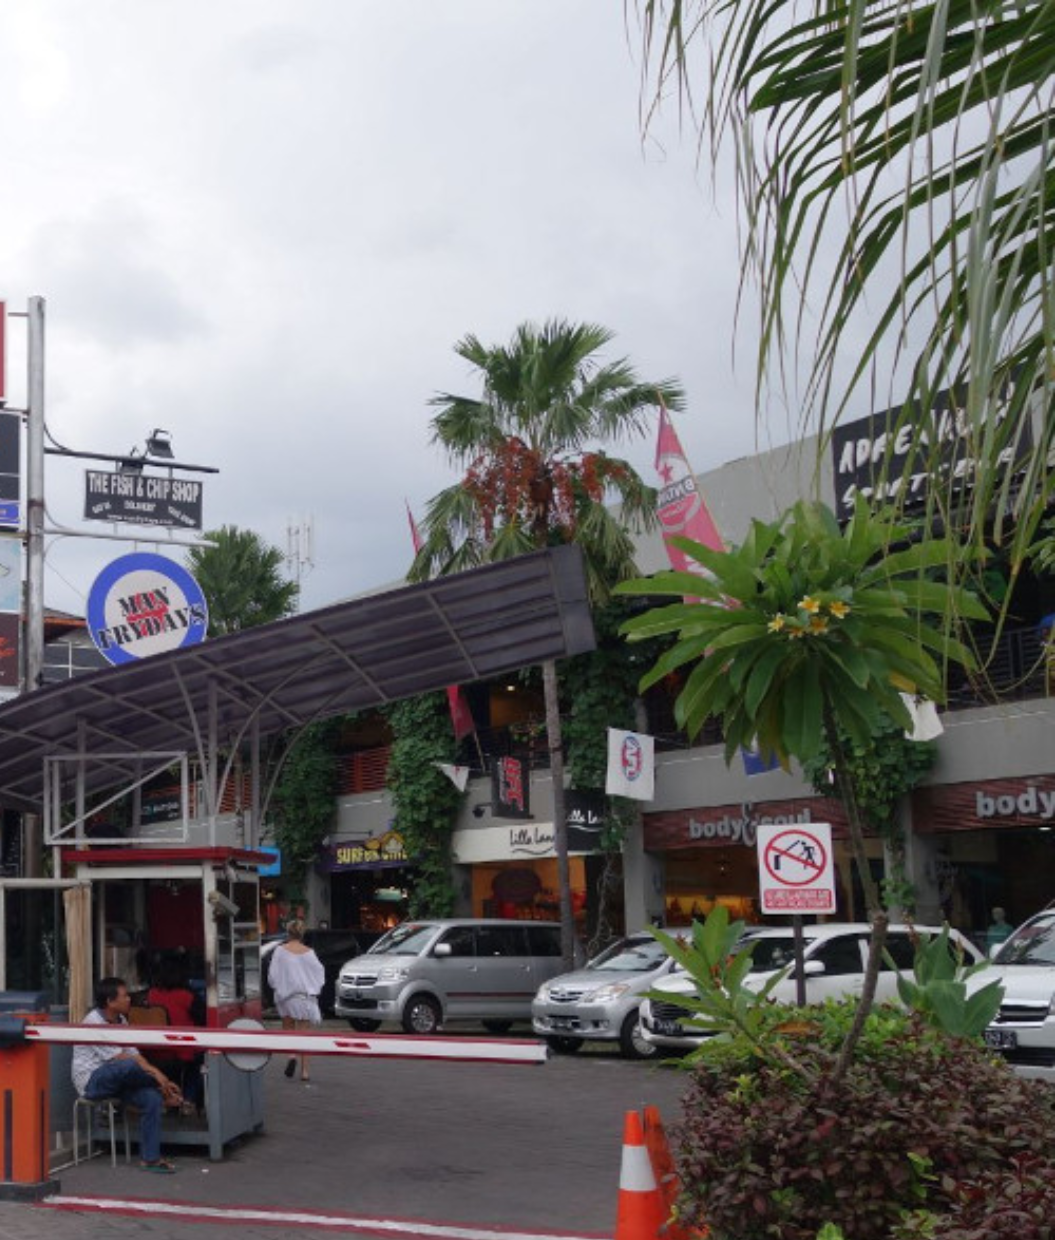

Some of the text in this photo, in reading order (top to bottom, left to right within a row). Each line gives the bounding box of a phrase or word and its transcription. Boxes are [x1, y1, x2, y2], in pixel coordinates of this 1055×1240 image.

[88, 472, 199, 503] THE FISH & CHIP SHOP
[975, 786, 1055, 819] body
